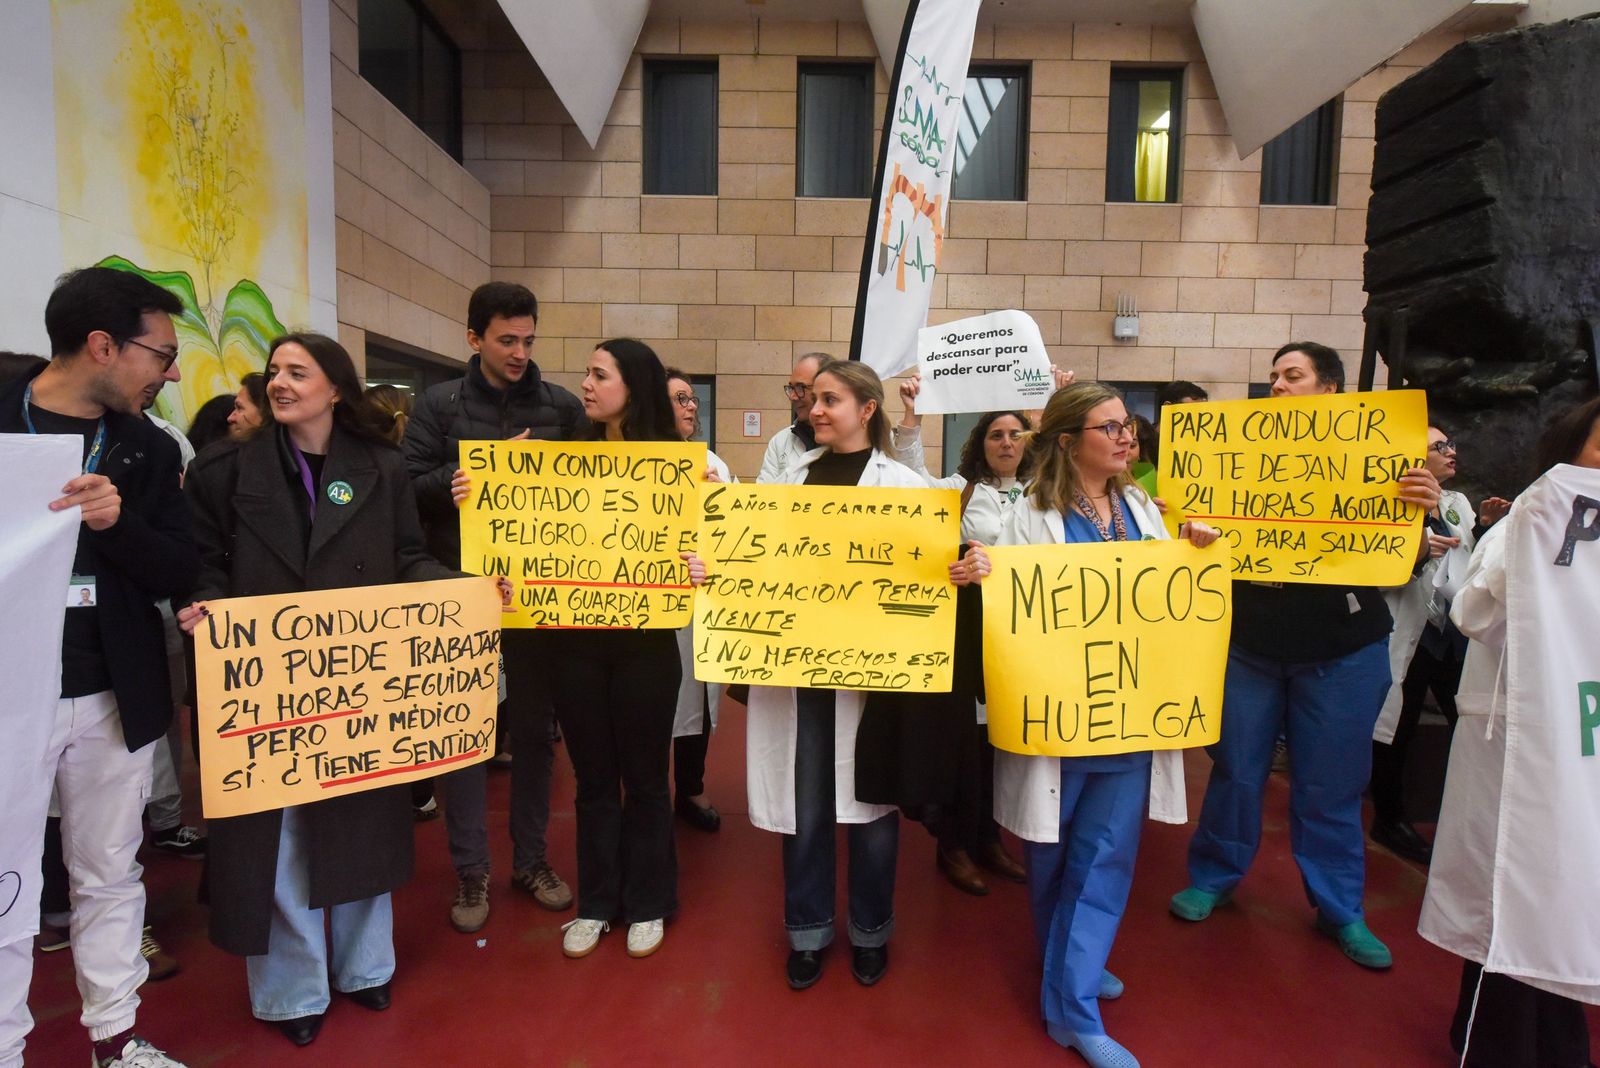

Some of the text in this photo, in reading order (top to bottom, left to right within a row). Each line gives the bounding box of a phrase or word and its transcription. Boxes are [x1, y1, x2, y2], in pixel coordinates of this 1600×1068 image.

[926, 344, 1028, 362] descansar para
[934, 363, 972, 380] poder
[1170, 402, 1390, 444] PARA CONDUCIR
[469, 444, 695, 488] SI UN CONDUCTOR
[1170, 450, 1202, 479] NO
[1213, 452, 1244, 480] TE
[1257, 453, 1347, 482] DEJAN
[476, 481, 684, 516] AGOTADO ES UN
[703, 486, 726, 515] 6
[731, 494, 778, 512] AÑOS
[791, 502, 812, 513] DE
[822, 502, 923, 518] CARRERA
[1181, 483, 1214, 514] 24
[1232, 490, 1314, 518] HORAS
[774, 536, 831, 558] AÑOS
[848, 539, 894, 560] MIR
[1256, 528, 1306, 551] PARA
[1320, 531, 1406, 558] SALVAR
[482, 553, 691, 586] UN MÉDICO AGOTAD
[520, 587, 691, 614] UNA GUARDIA DE
[701, 574, 951, 602] FORMACION PERMA
[1011, 556, 1226, 634] MÉDICOS
[208, 600, 464, 650] UN CONDUCTOR
[530, 610, 560, 626] 24
[702, 608, 796, 630] NENTE
[224, 656, 264, 692] NO
[282, 640, 388, 684] PUEDE
[401, 629, 501, 668] TRABAJAR
[764, 644, 897, 667] MERECEMOS
[907, 652, 950, 666] ESTA
[1085, 637, 1139, 698] EN
[724, 666, 773, 680] TUTO
[217, 699, 260, 733] 24
[277, 682, 369, 722] HORAS
[382, 662, 495, 702] SEGUIDAS
[248, 703, 470, 760] PERO UN MÉDICO
[1022, 695, 1206, 744] HUELGA
